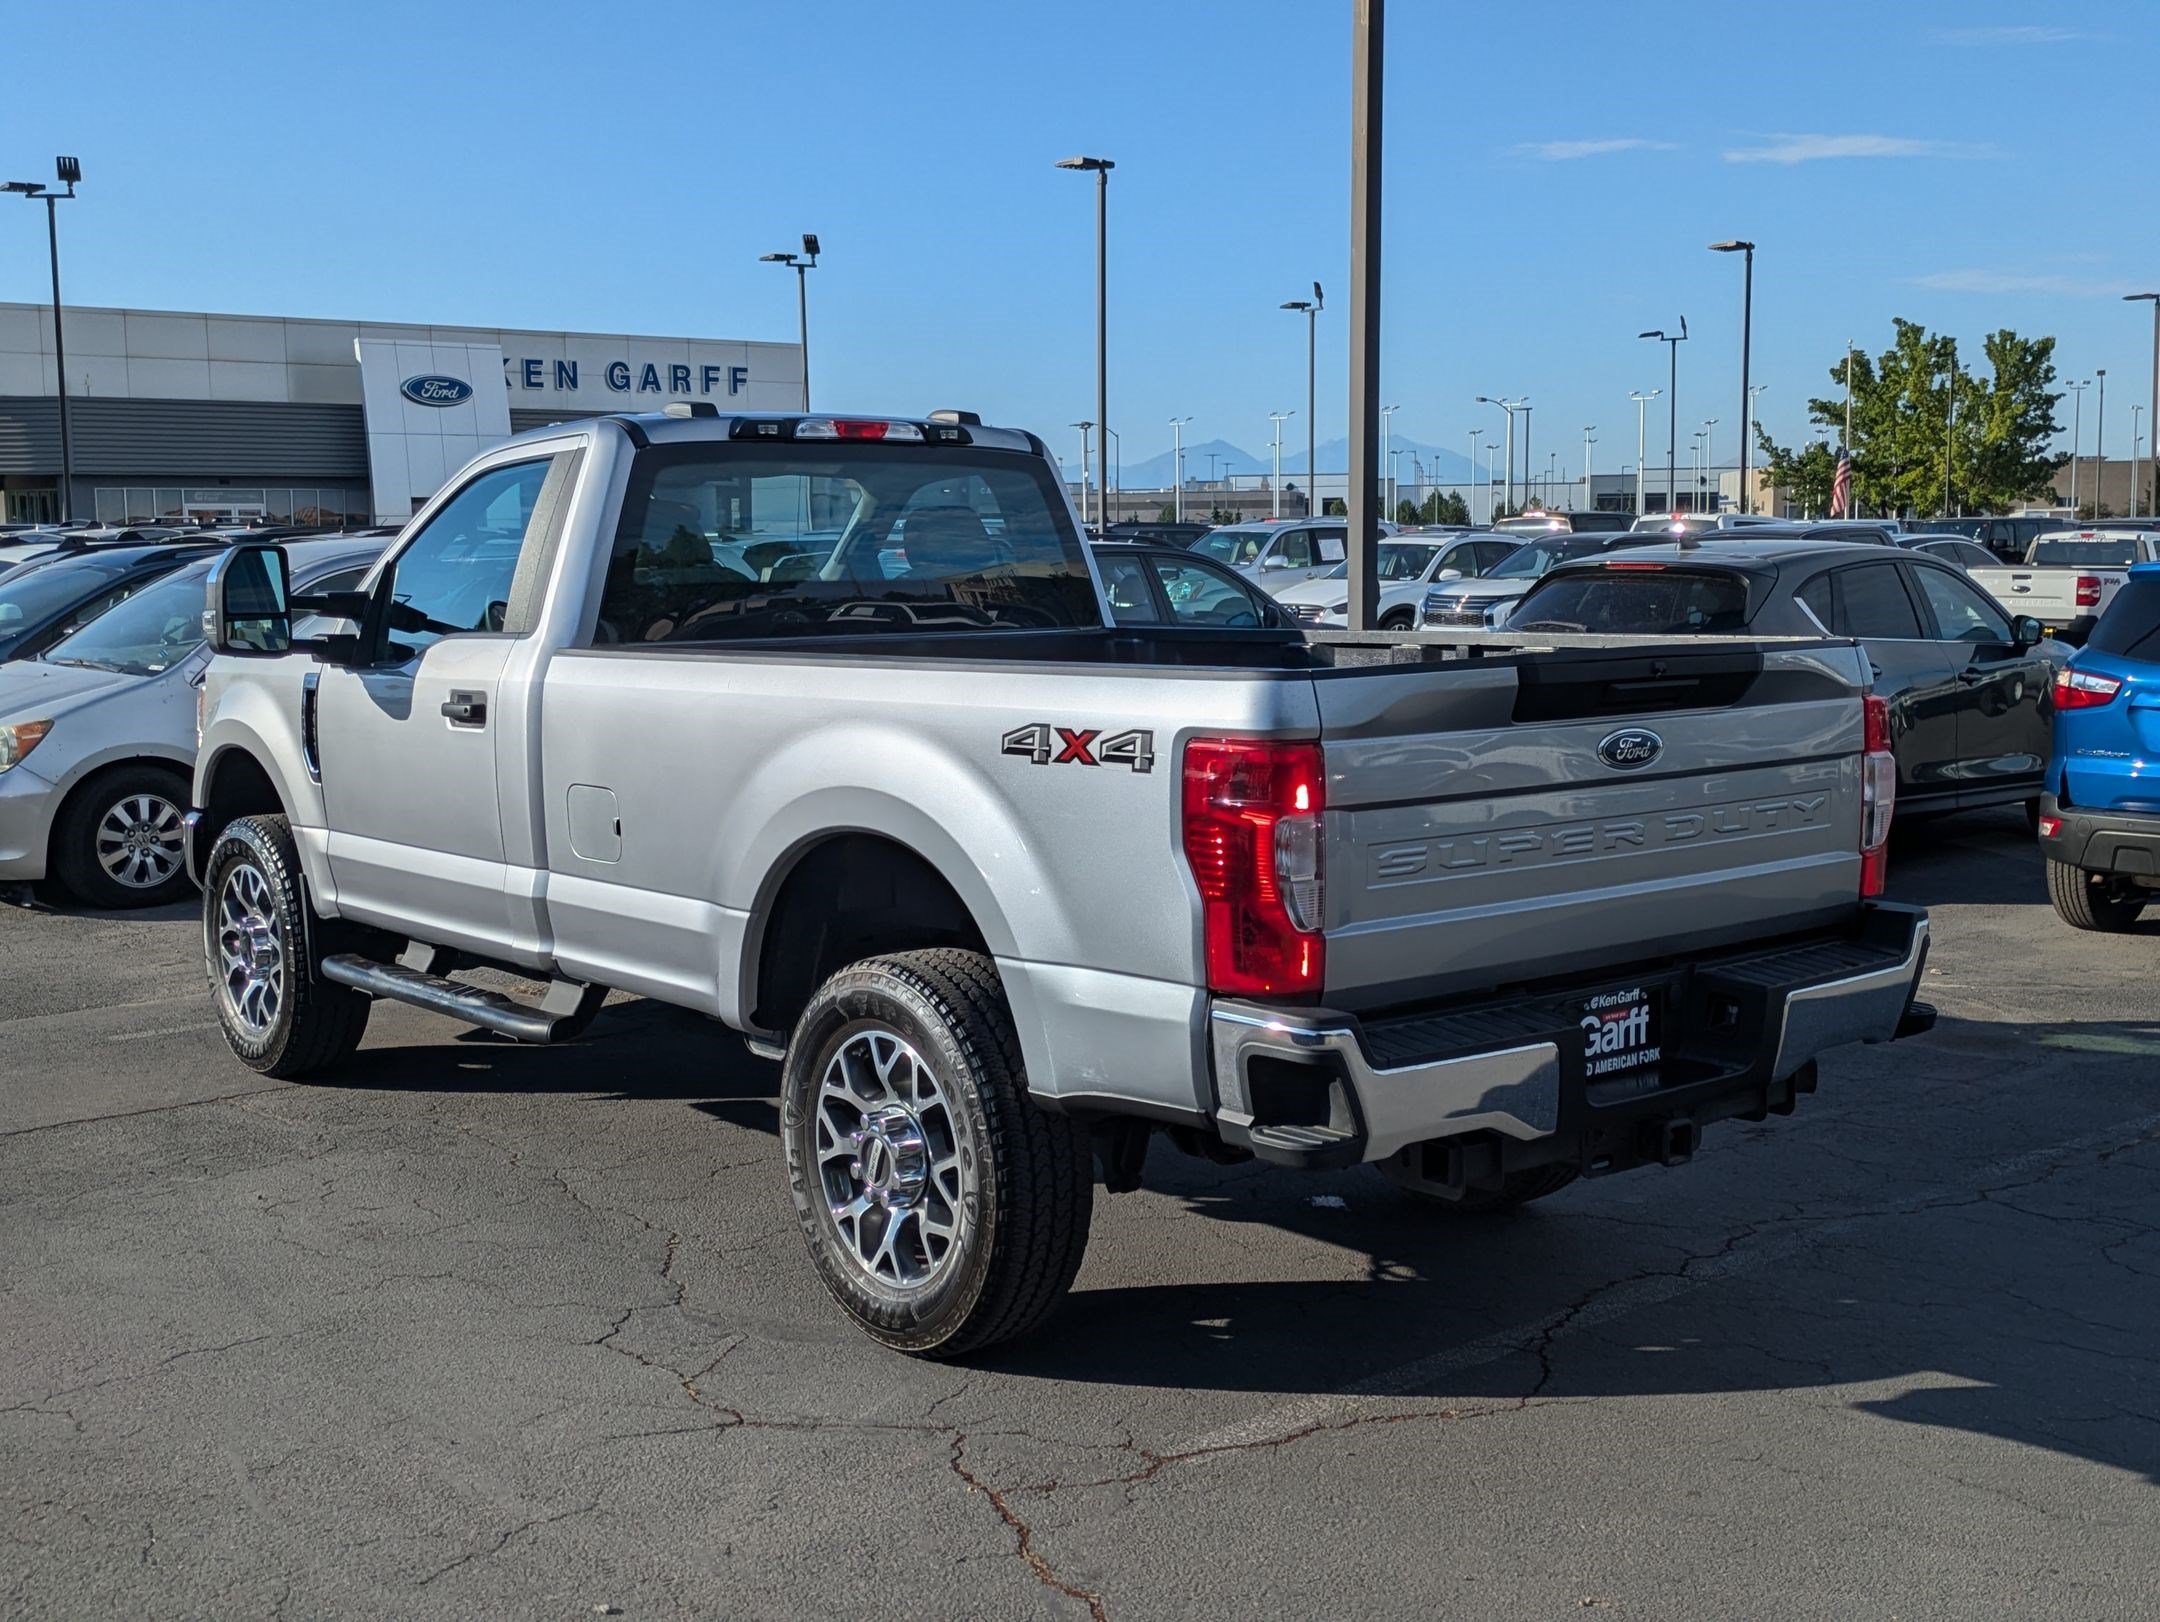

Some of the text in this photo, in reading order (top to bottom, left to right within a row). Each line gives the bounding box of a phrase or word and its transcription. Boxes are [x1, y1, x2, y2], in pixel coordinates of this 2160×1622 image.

[421, 380, 460, 399] Ford
[606, 361, 748, 394] GARFF
[1616, 737, 1652, 760] Ford
[1377, 795, 1827, 876] SUPER DUTY
[1599, 988, 1640, 1008] Ken Garff
[1580, 1005, 1649, 1056] Garff
[1595, 1053, 1637, 1074] AMERICAN
[1640, 1048, 1661, 1064] FORK
